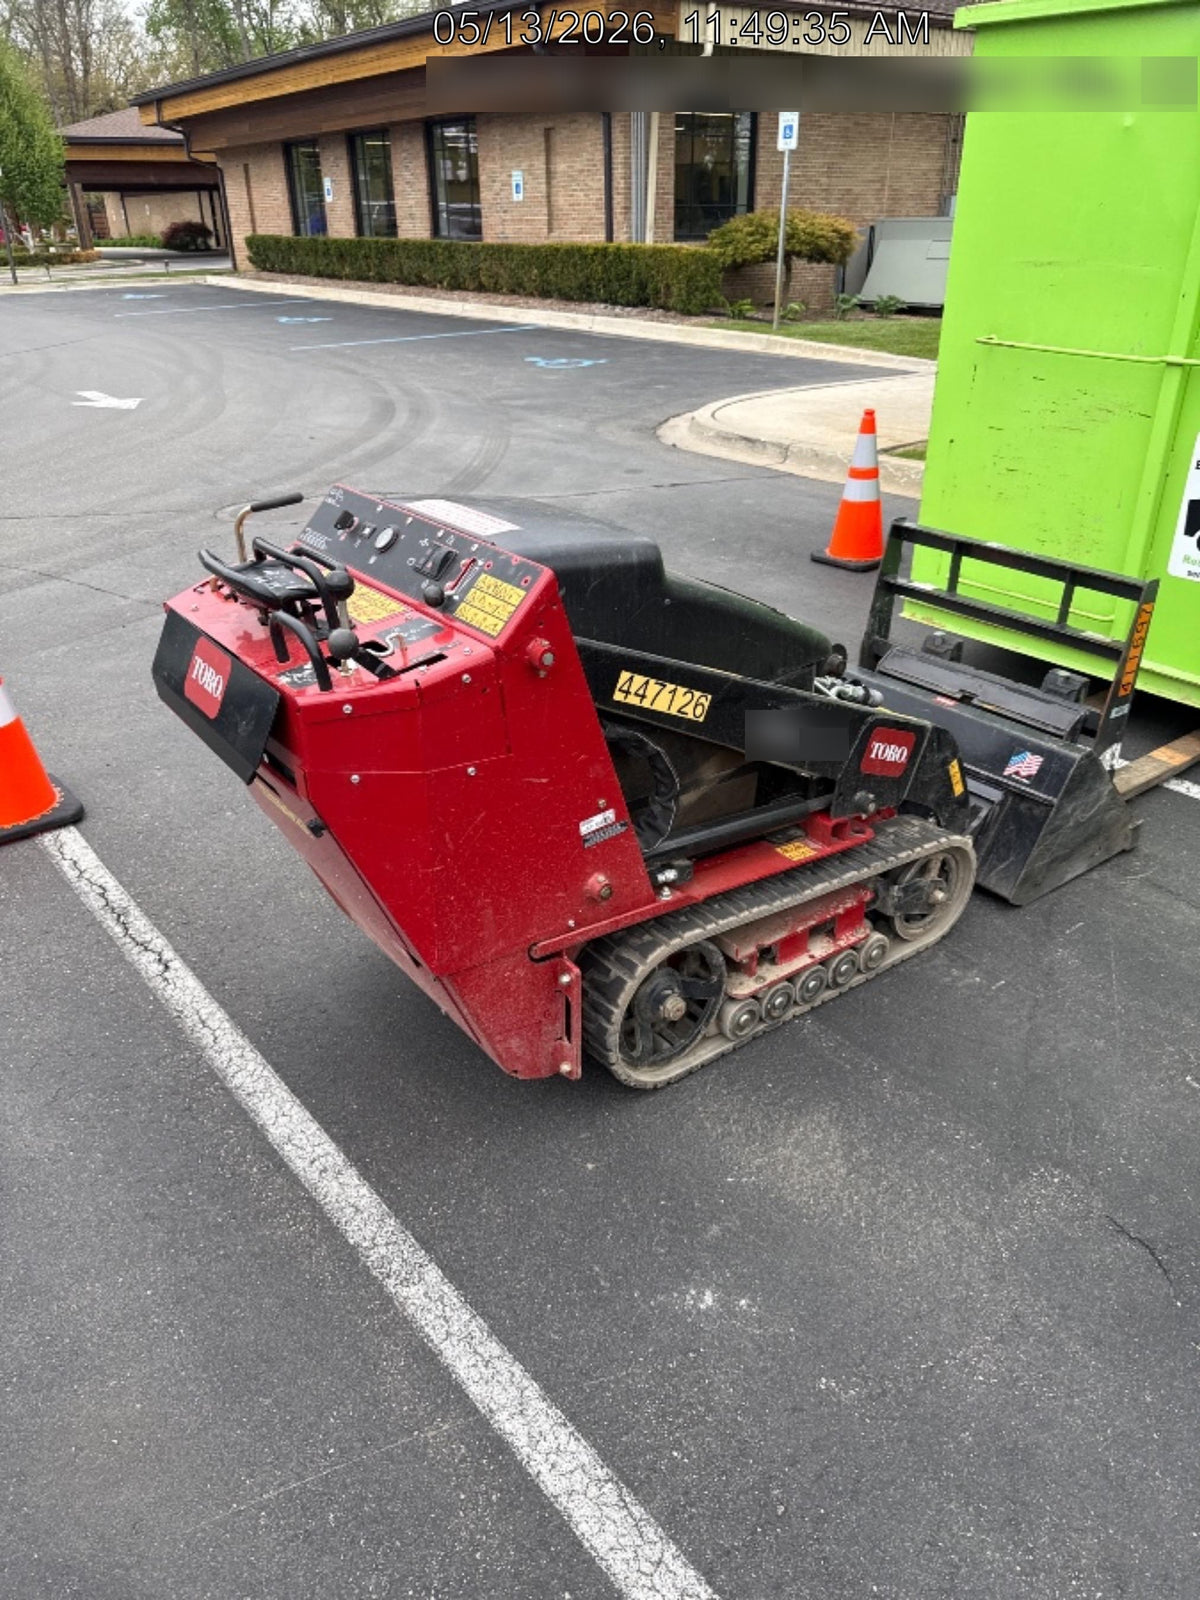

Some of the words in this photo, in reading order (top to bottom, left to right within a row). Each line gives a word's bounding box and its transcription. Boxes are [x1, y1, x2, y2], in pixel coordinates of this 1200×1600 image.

[191, 655, 223, 698] TORO
[617, 674, 709, 719] 447126
[869, 741, 908, 763] TORO
